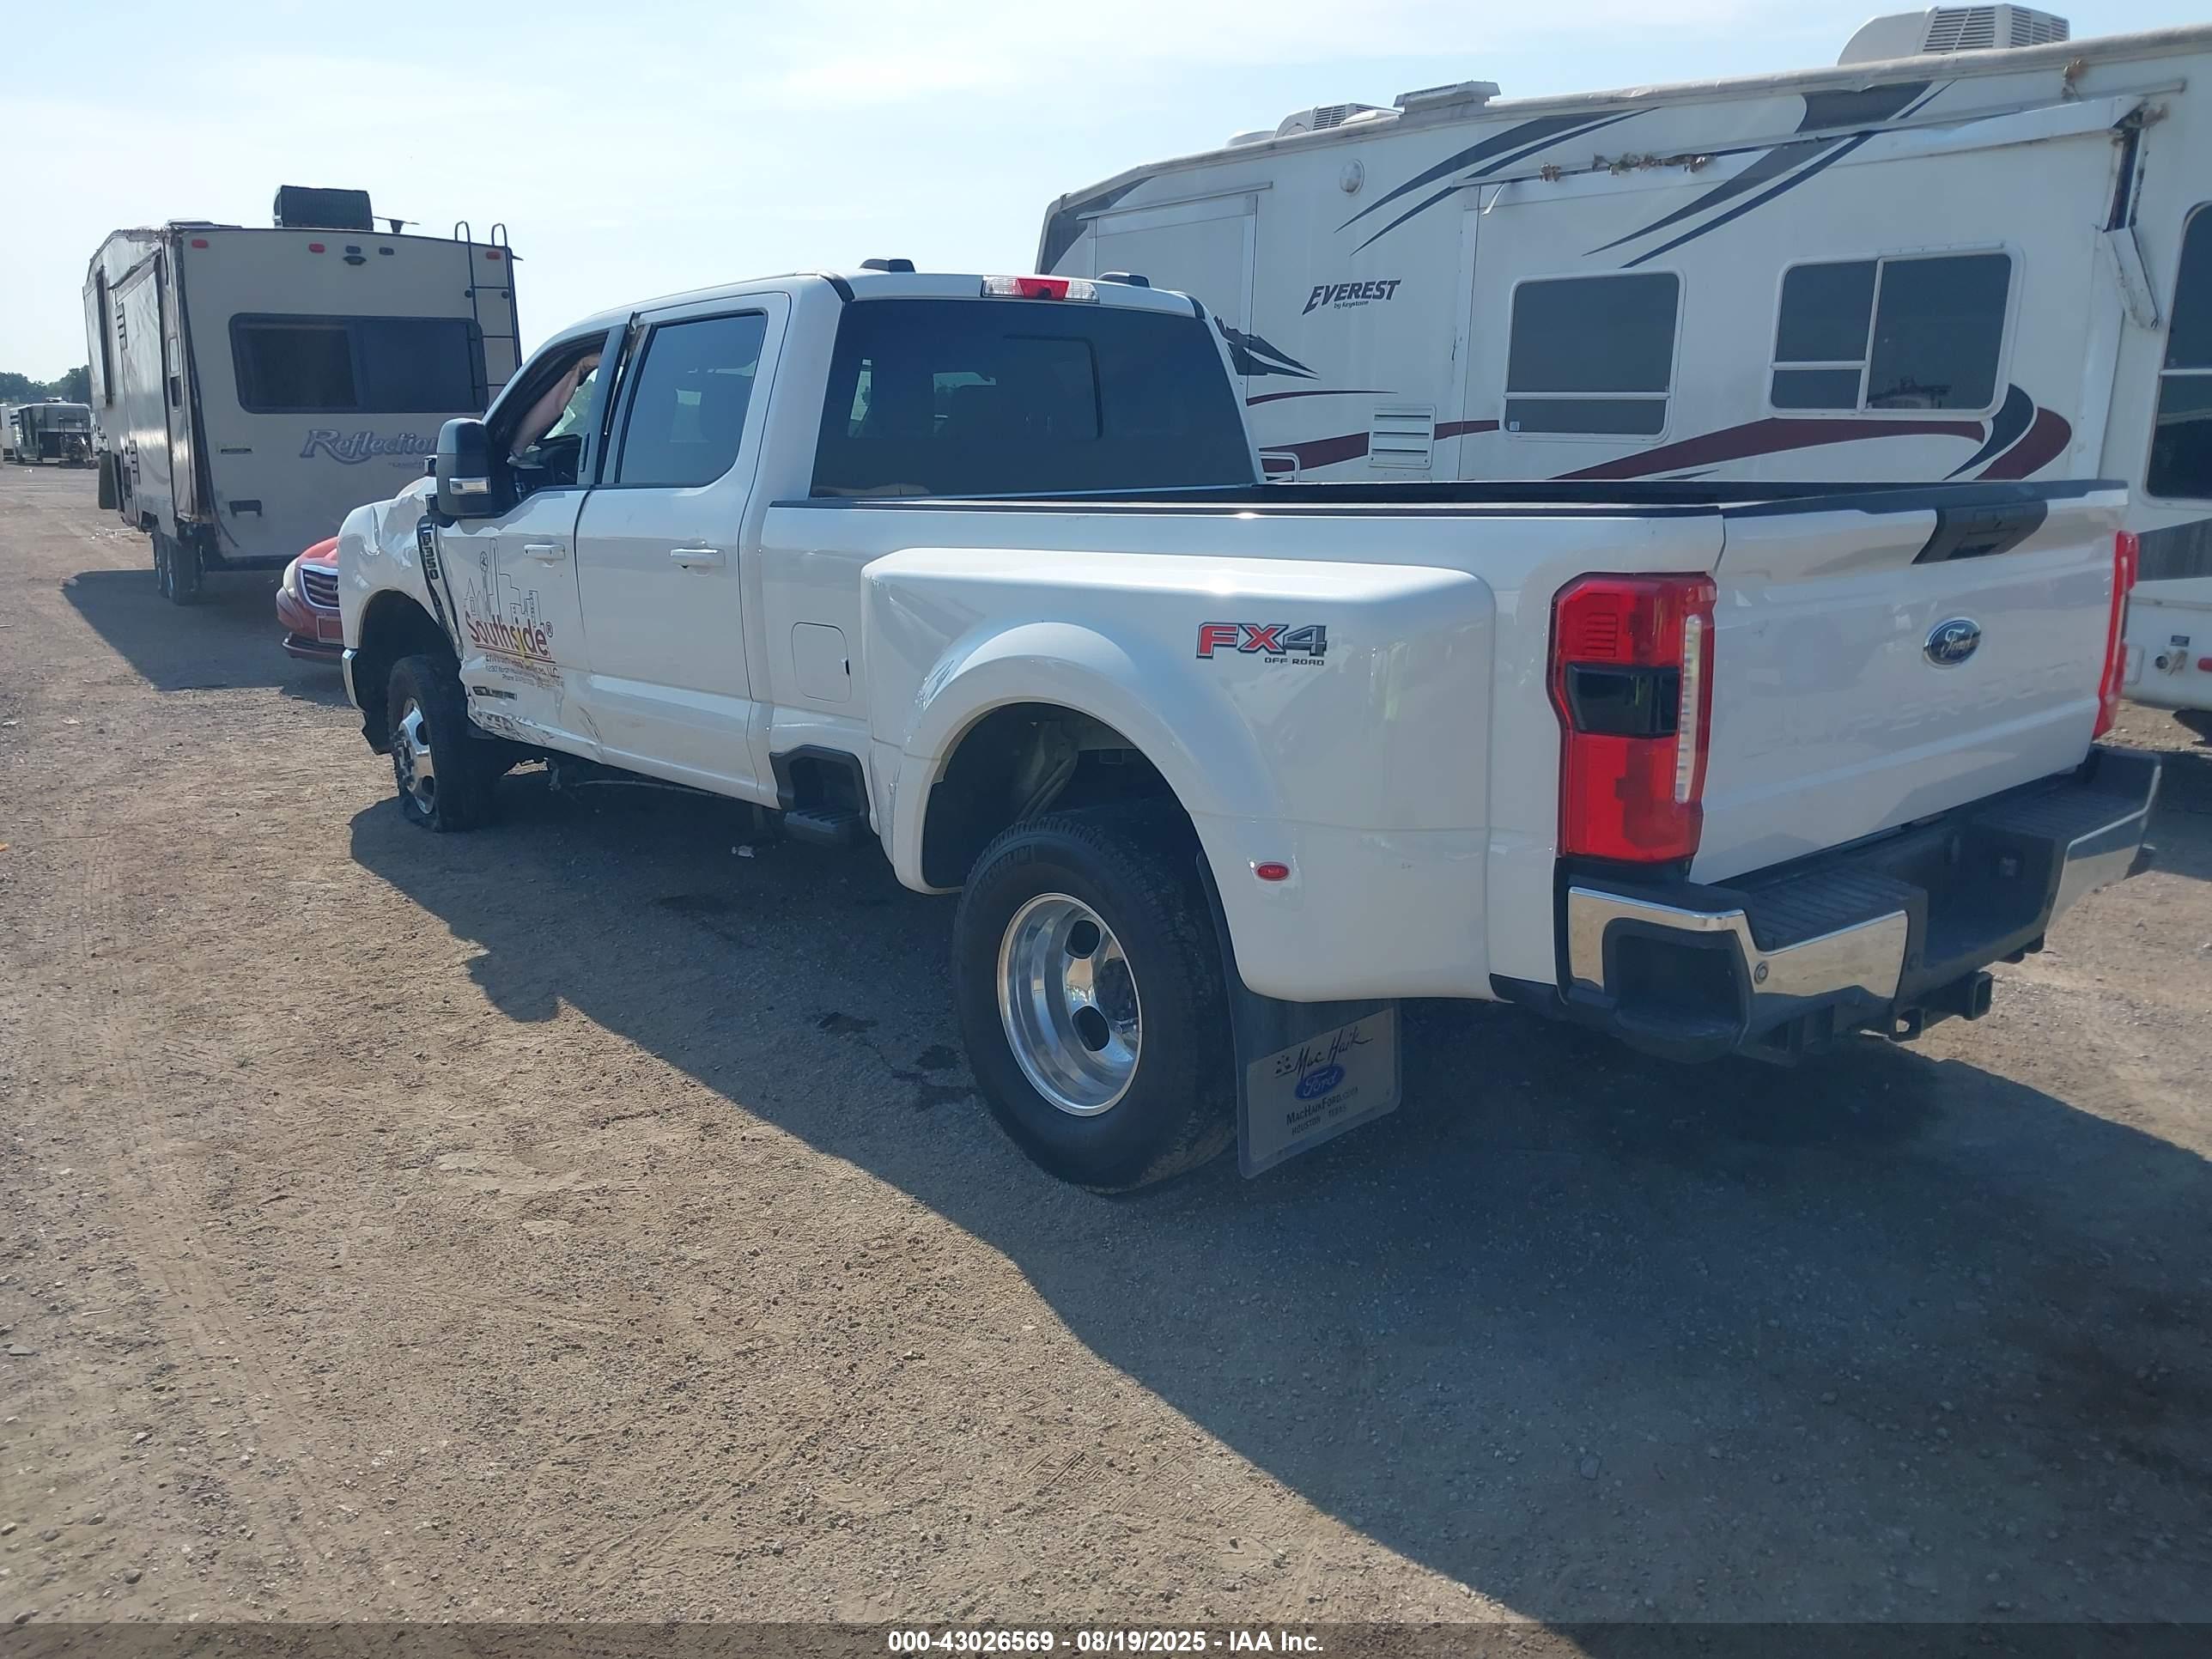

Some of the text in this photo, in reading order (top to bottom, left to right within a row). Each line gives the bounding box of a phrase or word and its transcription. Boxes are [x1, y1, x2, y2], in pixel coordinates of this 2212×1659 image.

[1302, 278, 1401, 315] EVEREST
[1196, 622, 1328, 659] FX4
[1941, 628, 1973, 658] Ford
[1291, 658, 1325, 666] ROAD
[1279, 1026, 1374, 1079] Mac Haik
[1303, 1070, 1339, 1097] Ford
